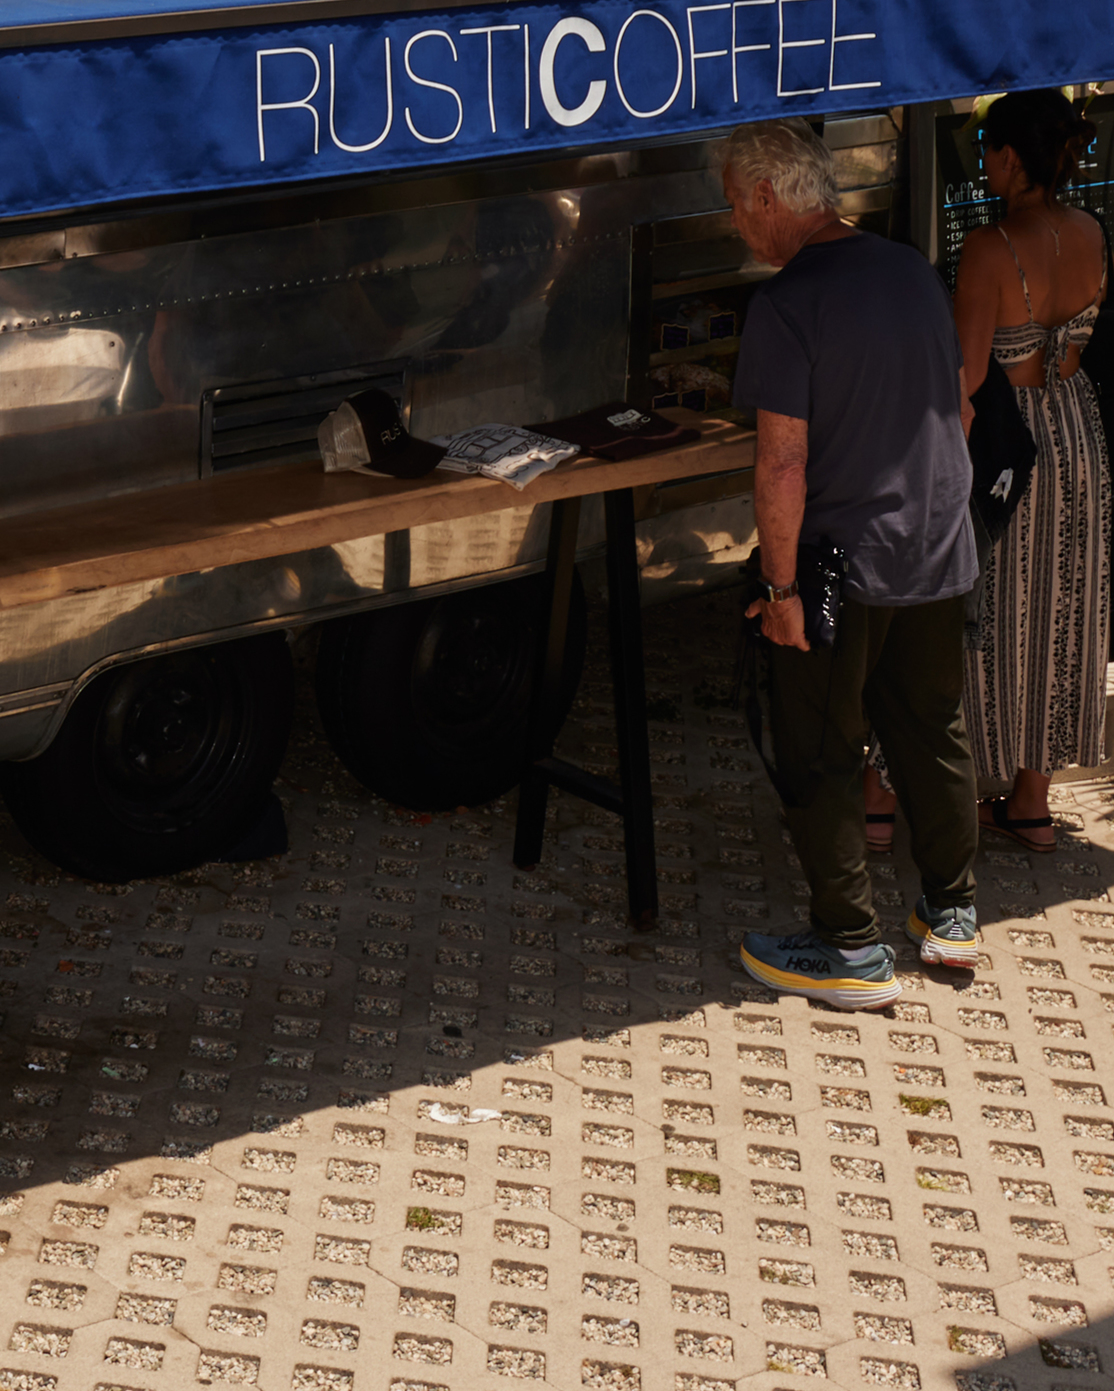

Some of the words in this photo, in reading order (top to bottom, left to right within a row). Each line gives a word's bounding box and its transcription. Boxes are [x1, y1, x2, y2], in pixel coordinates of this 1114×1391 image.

[945, 181, 985, 204] Coffee
[950, 219, 965, 230] ICED
[785, 956, 831, 975] HOKA
